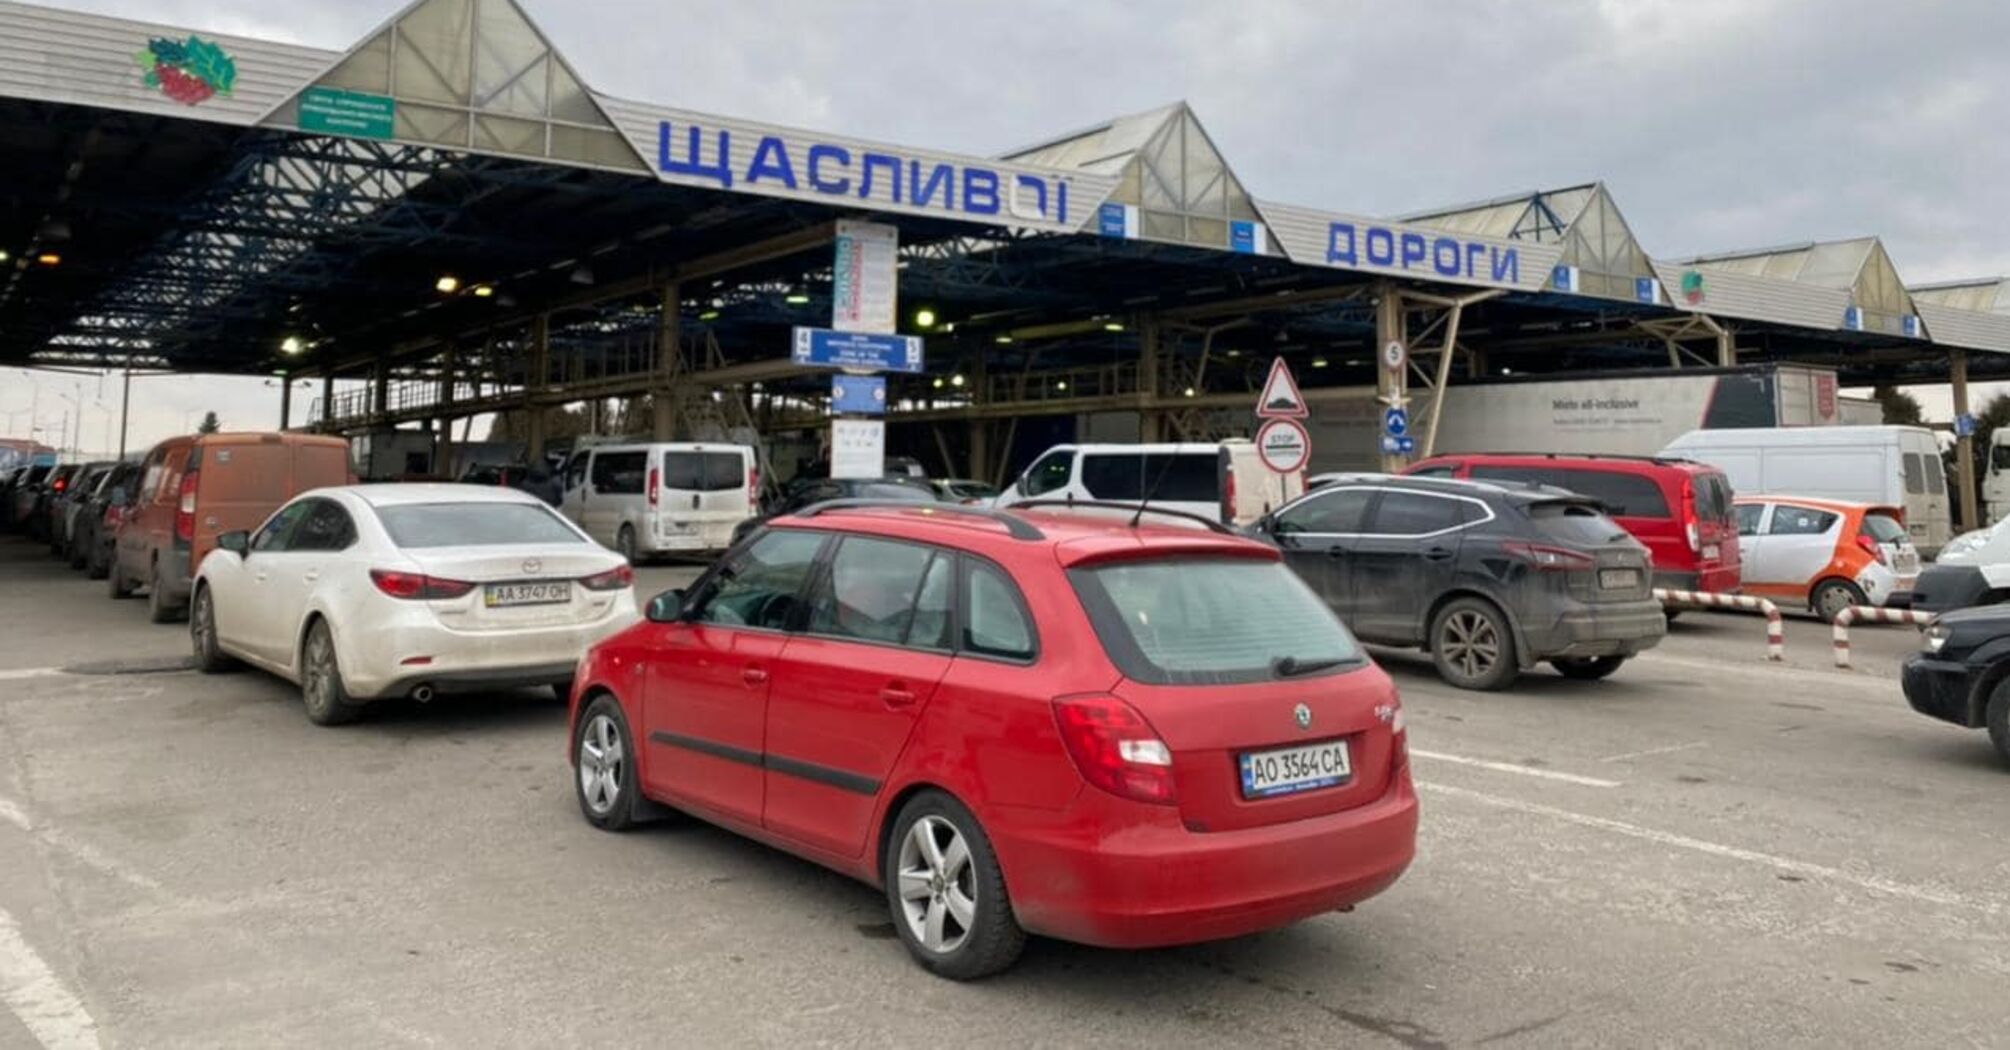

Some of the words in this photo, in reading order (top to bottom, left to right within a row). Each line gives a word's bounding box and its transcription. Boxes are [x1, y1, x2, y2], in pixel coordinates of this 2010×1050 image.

[1326, 221, 1519, 283] ДОРОГИ
[1390, 345, 1399, 361] 5
[1270, 434, 1296, 444] STOP
[496, 586, 515, 601] AA
[518, 586, 547, 600] 3747
[550, 585, 569, 599] OH
[1254, 756, 1278, 785] AO
[1281, 751, 1320, 780] 3564
[1321, 747, 1345, 774] CA
